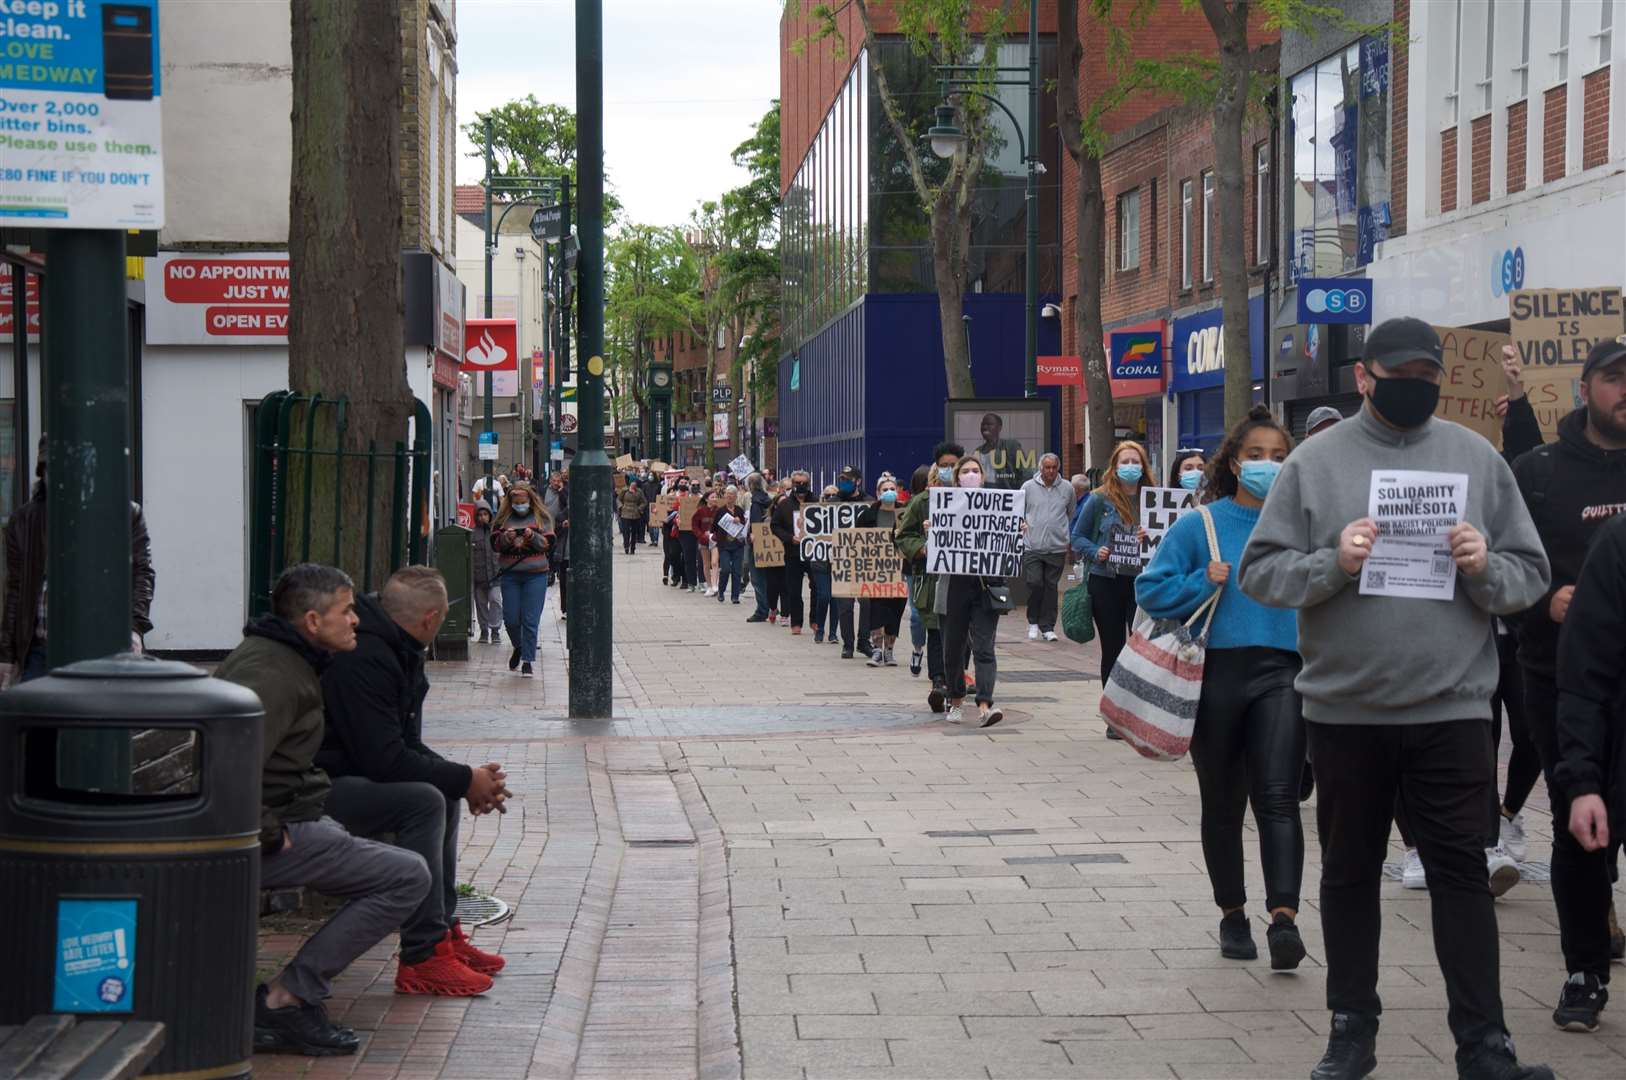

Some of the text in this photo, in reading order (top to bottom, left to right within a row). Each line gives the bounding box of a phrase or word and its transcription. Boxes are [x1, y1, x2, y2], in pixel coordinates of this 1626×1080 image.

[67, 0, 86, 18] it
[0, 64, 97, 85] MEDWAY
[45, 101, 99, 117] 2,000
[47, 119, 93, 134] bins.
[64, 141, 97, 152] use
[104, 141, 157, 155] them.
[27, 169, 57, 182] FINE
[62, 171, 75, 183] IF
[80, 172, 105, 184] YOU
[110, 173, 150, 185] DON'T
[170, 265, 196, 279] NO
[223, 285, 289, 299] JUST W
[1511, 290, 1621, 321] SILENCE
[213, 314, 260, 328] OPEN
[1557, 320, 1580, 336] IS
[1036, 364, 1079, 374] Ryman
[1116, 364, 1160, 376] CORAL
[713, 388, 732, 398] PLP
[1378, 485, 1455, 500] SOLIDARITY
[937, 492, 953, 509] IF
[1377, 502, 1457, 516] MINNESOTA
[932, 513, 956, 528] NOT
[833, 546, 843, 558] IT
[846, 546, 858, 558] IS
[1114, 545, 1137, 554] LIVES
[833, 558, 851, 571] TO
[933, 550, 1023, 576] ATTENTION
[833, 570, 851, 583] WE
[855, 571, 896, 583] MUST
